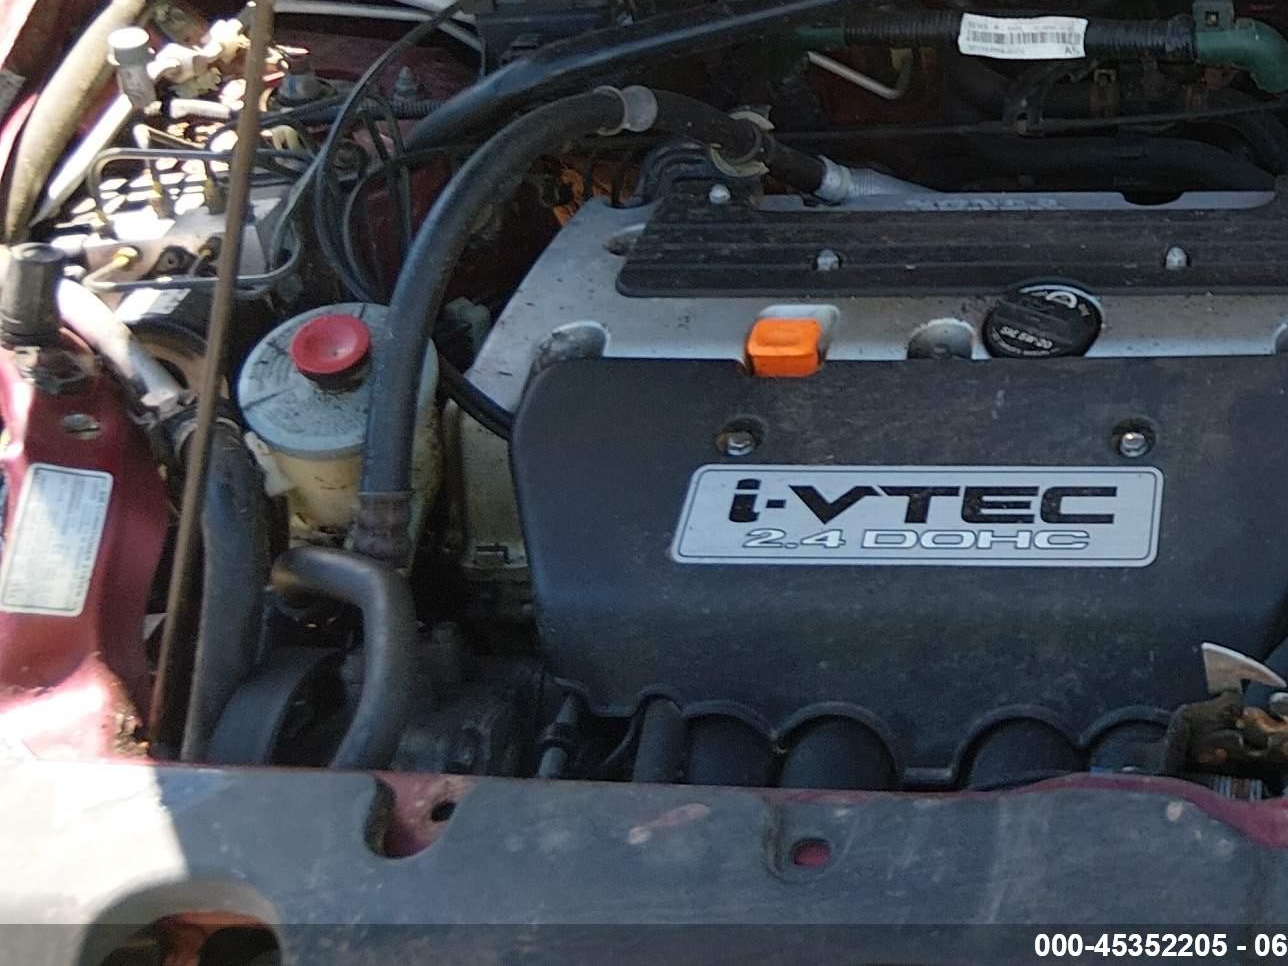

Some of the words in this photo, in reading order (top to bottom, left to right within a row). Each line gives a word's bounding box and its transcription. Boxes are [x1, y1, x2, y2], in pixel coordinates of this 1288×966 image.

[728, 478, 1117, 525] i-VTEC
[742, 528, 847, 550] 2.4
[861, 529, 1090, 550] DOHC
